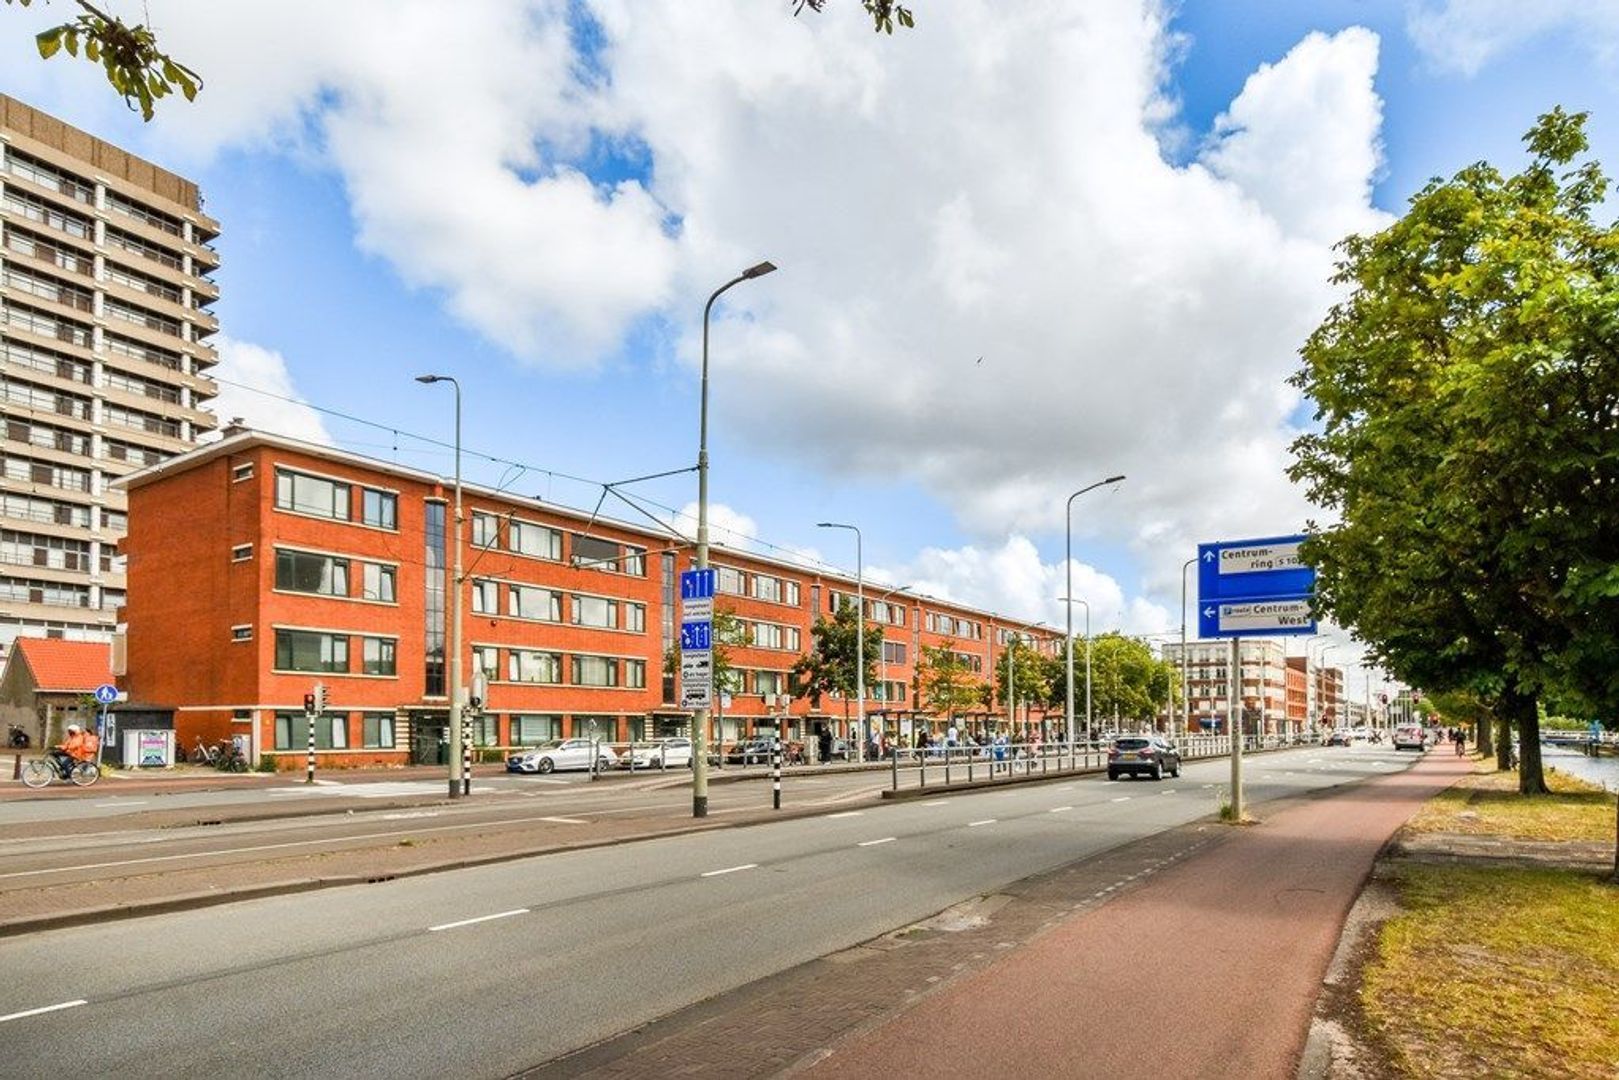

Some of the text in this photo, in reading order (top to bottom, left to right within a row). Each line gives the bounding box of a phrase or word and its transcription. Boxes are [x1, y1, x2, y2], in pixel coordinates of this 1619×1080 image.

[1221, 549, 1273, 560] Centrum-
[1250, 558, 1273, 569] ring
[1286, 557, 1300, 565] 10
[1253, 604, 1303, 614] Centrum-
[1278, 615, 1308, 625] West
